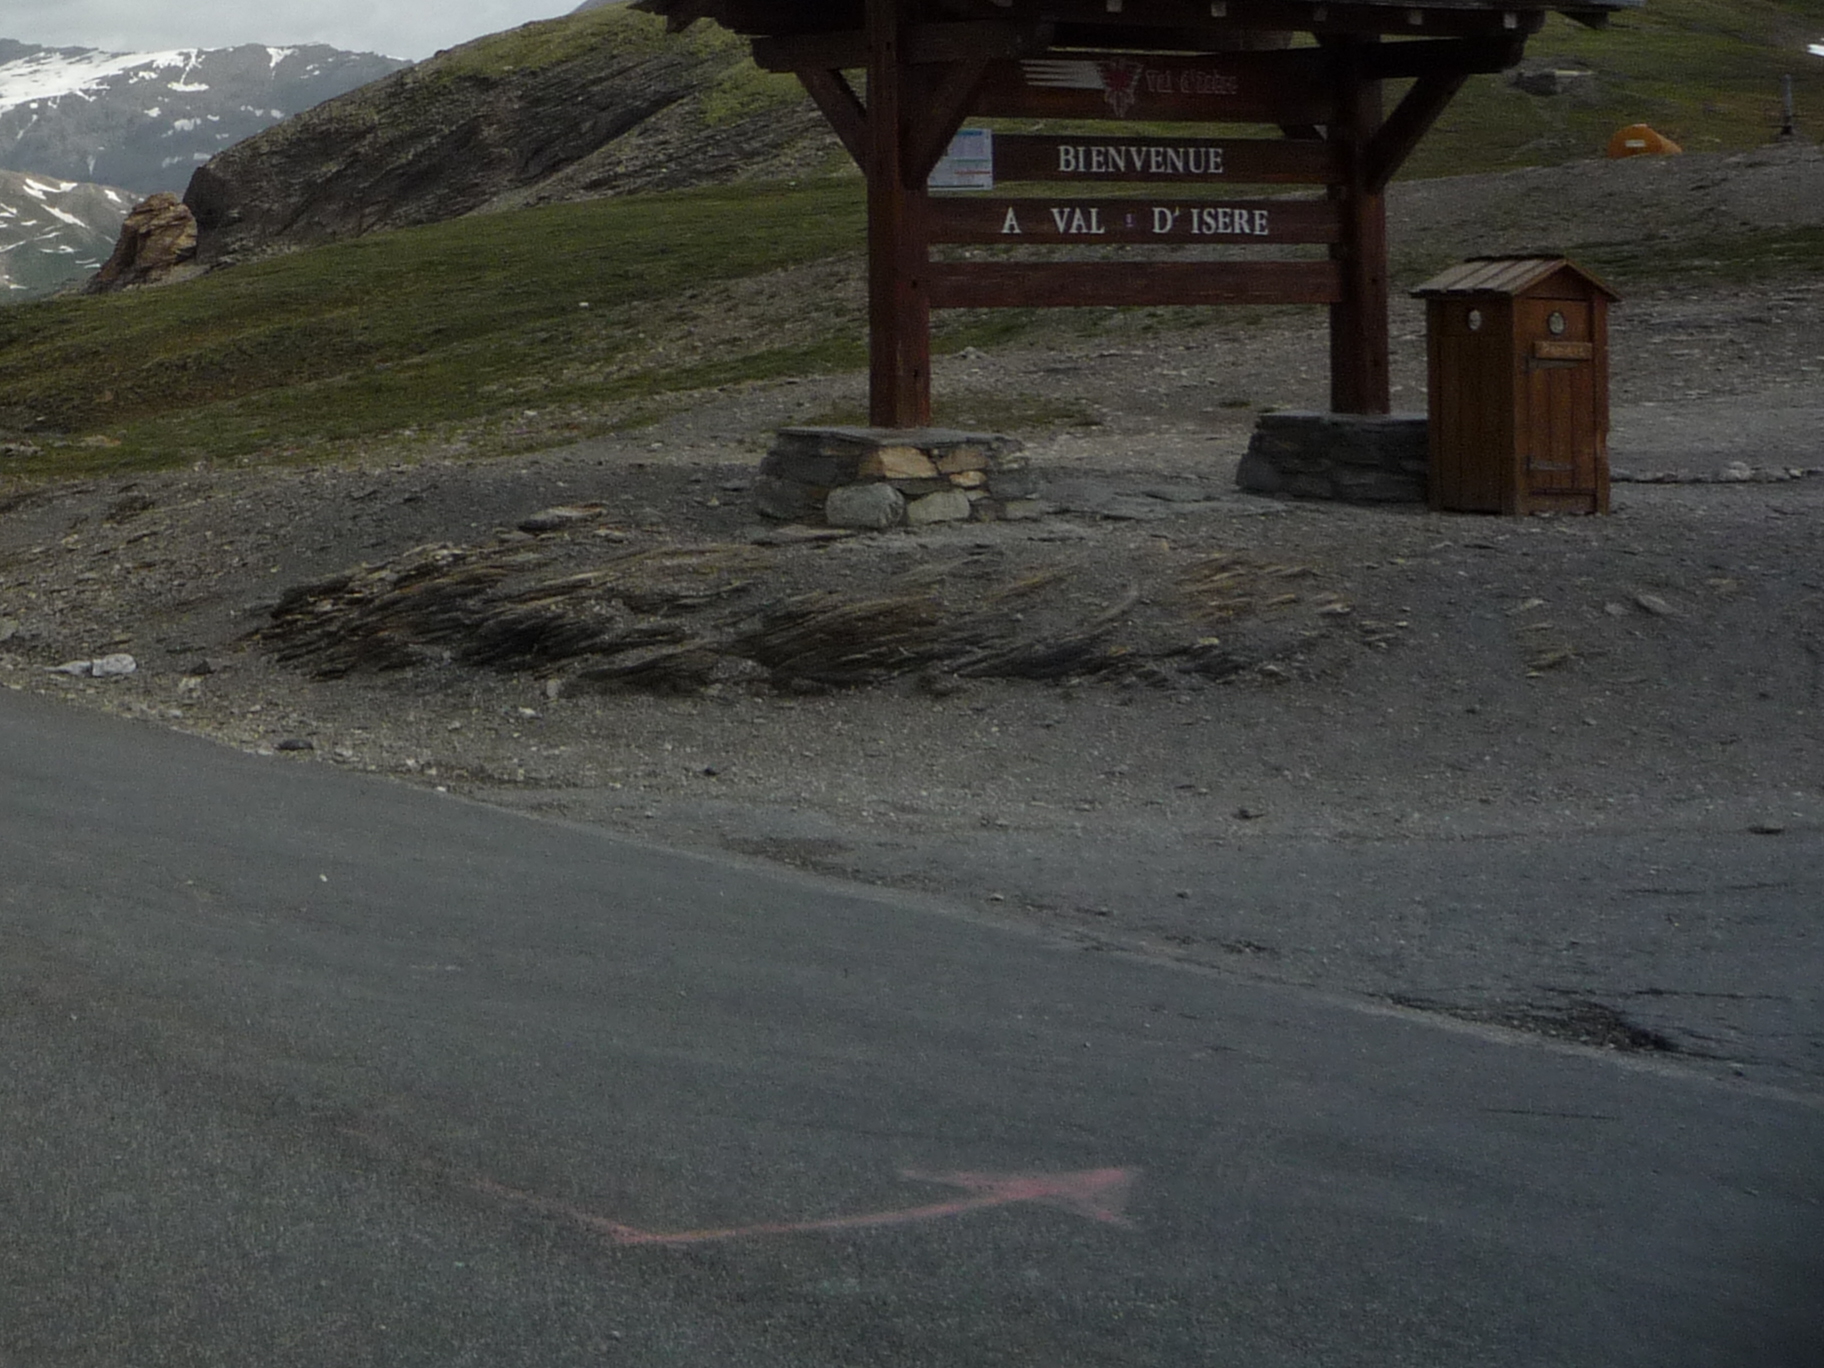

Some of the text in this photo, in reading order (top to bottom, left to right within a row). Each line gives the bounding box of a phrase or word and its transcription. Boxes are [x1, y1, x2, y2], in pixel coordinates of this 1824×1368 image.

[1058, 145, 1223, 173] BIENVENUE
[1001, 207, 1022, 233] A
[1050, 207, 1105, 234] VAL
